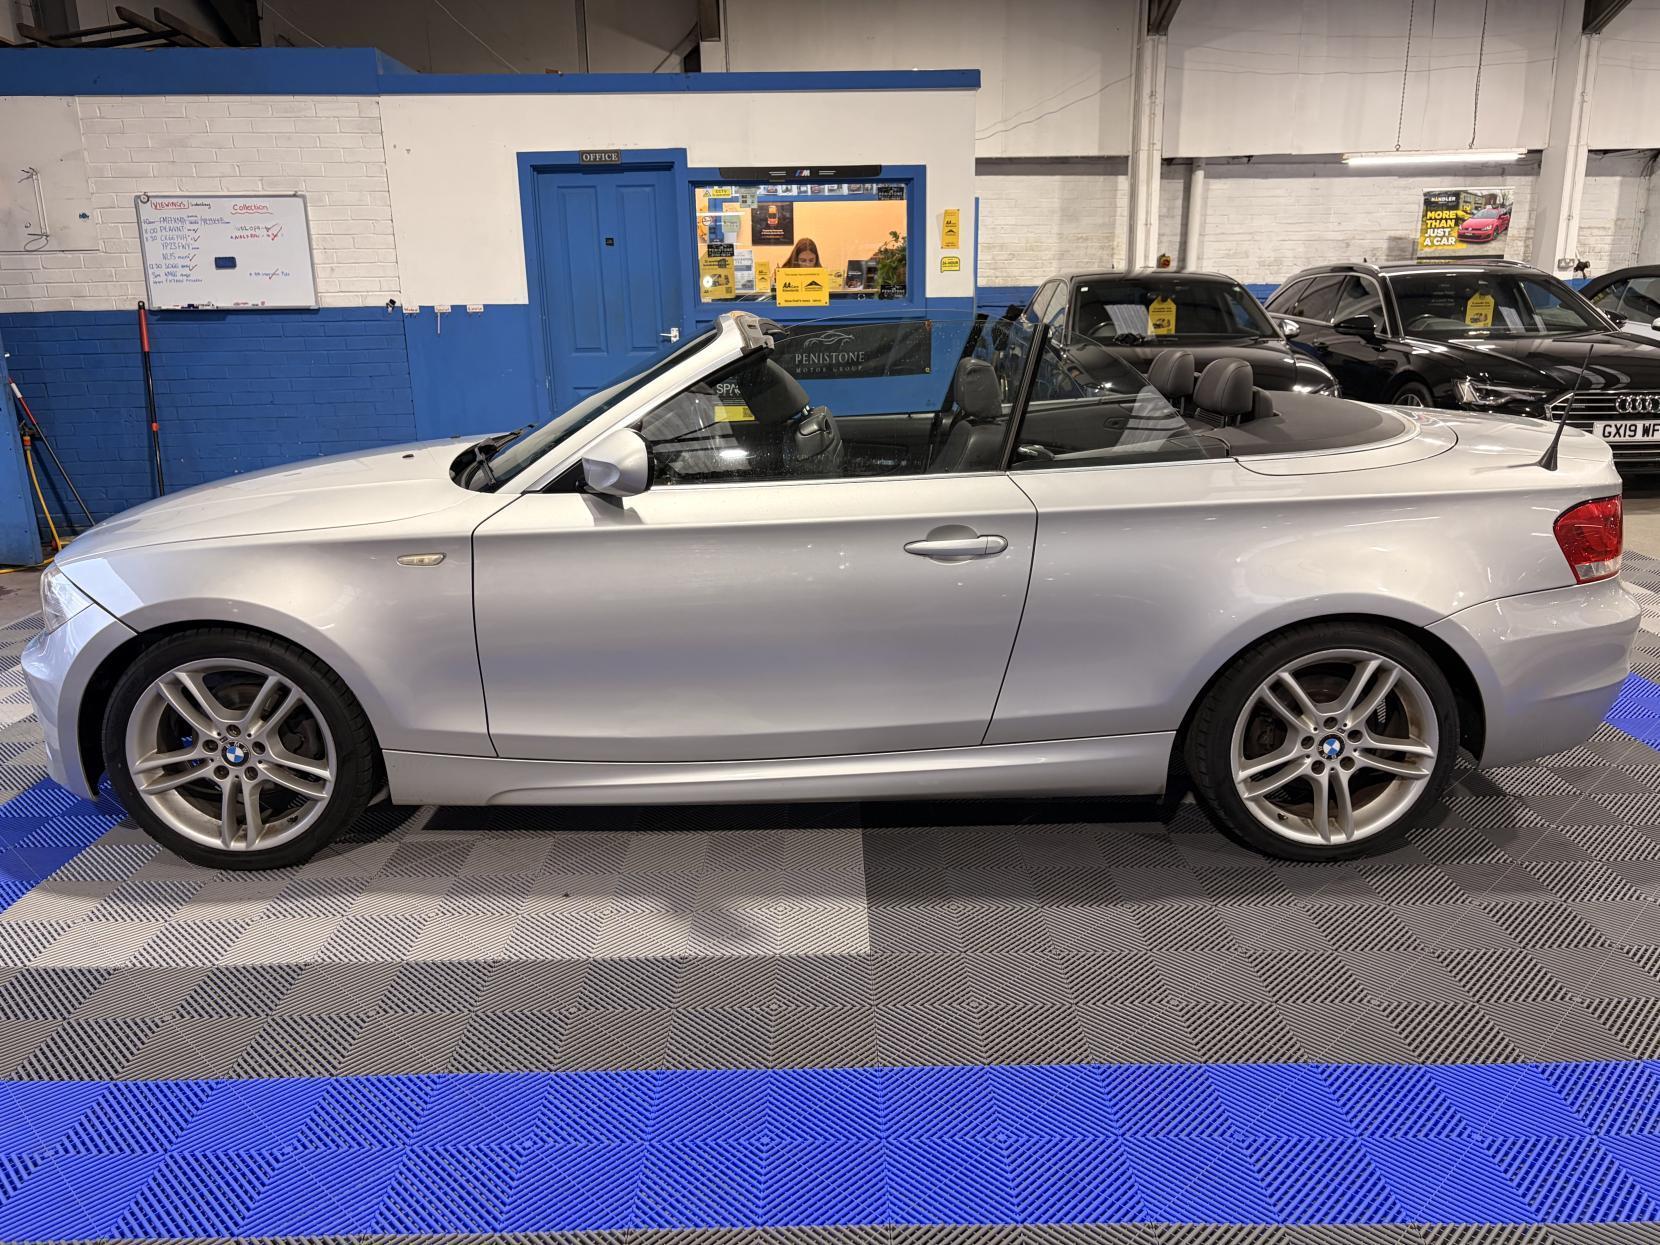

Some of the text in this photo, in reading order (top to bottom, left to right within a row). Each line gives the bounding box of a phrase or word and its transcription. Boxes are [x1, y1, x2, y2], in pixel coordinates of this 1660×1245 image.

[582, 153, 618, 161] OFFICE
[152, 201, 186, 209] VIEWINGS
[232, 204, 269, 212] Collection
[1426, 211, 1457, 220] MORE
[1426, 219, 1456, 228] THAN
[1425, 228, 1451, 237] JUST
[1423, 237, 1456, 246] A CAR
[795, 351, 865, 365] PENISTONE
[1602, 424, 1638, 438] GX19
